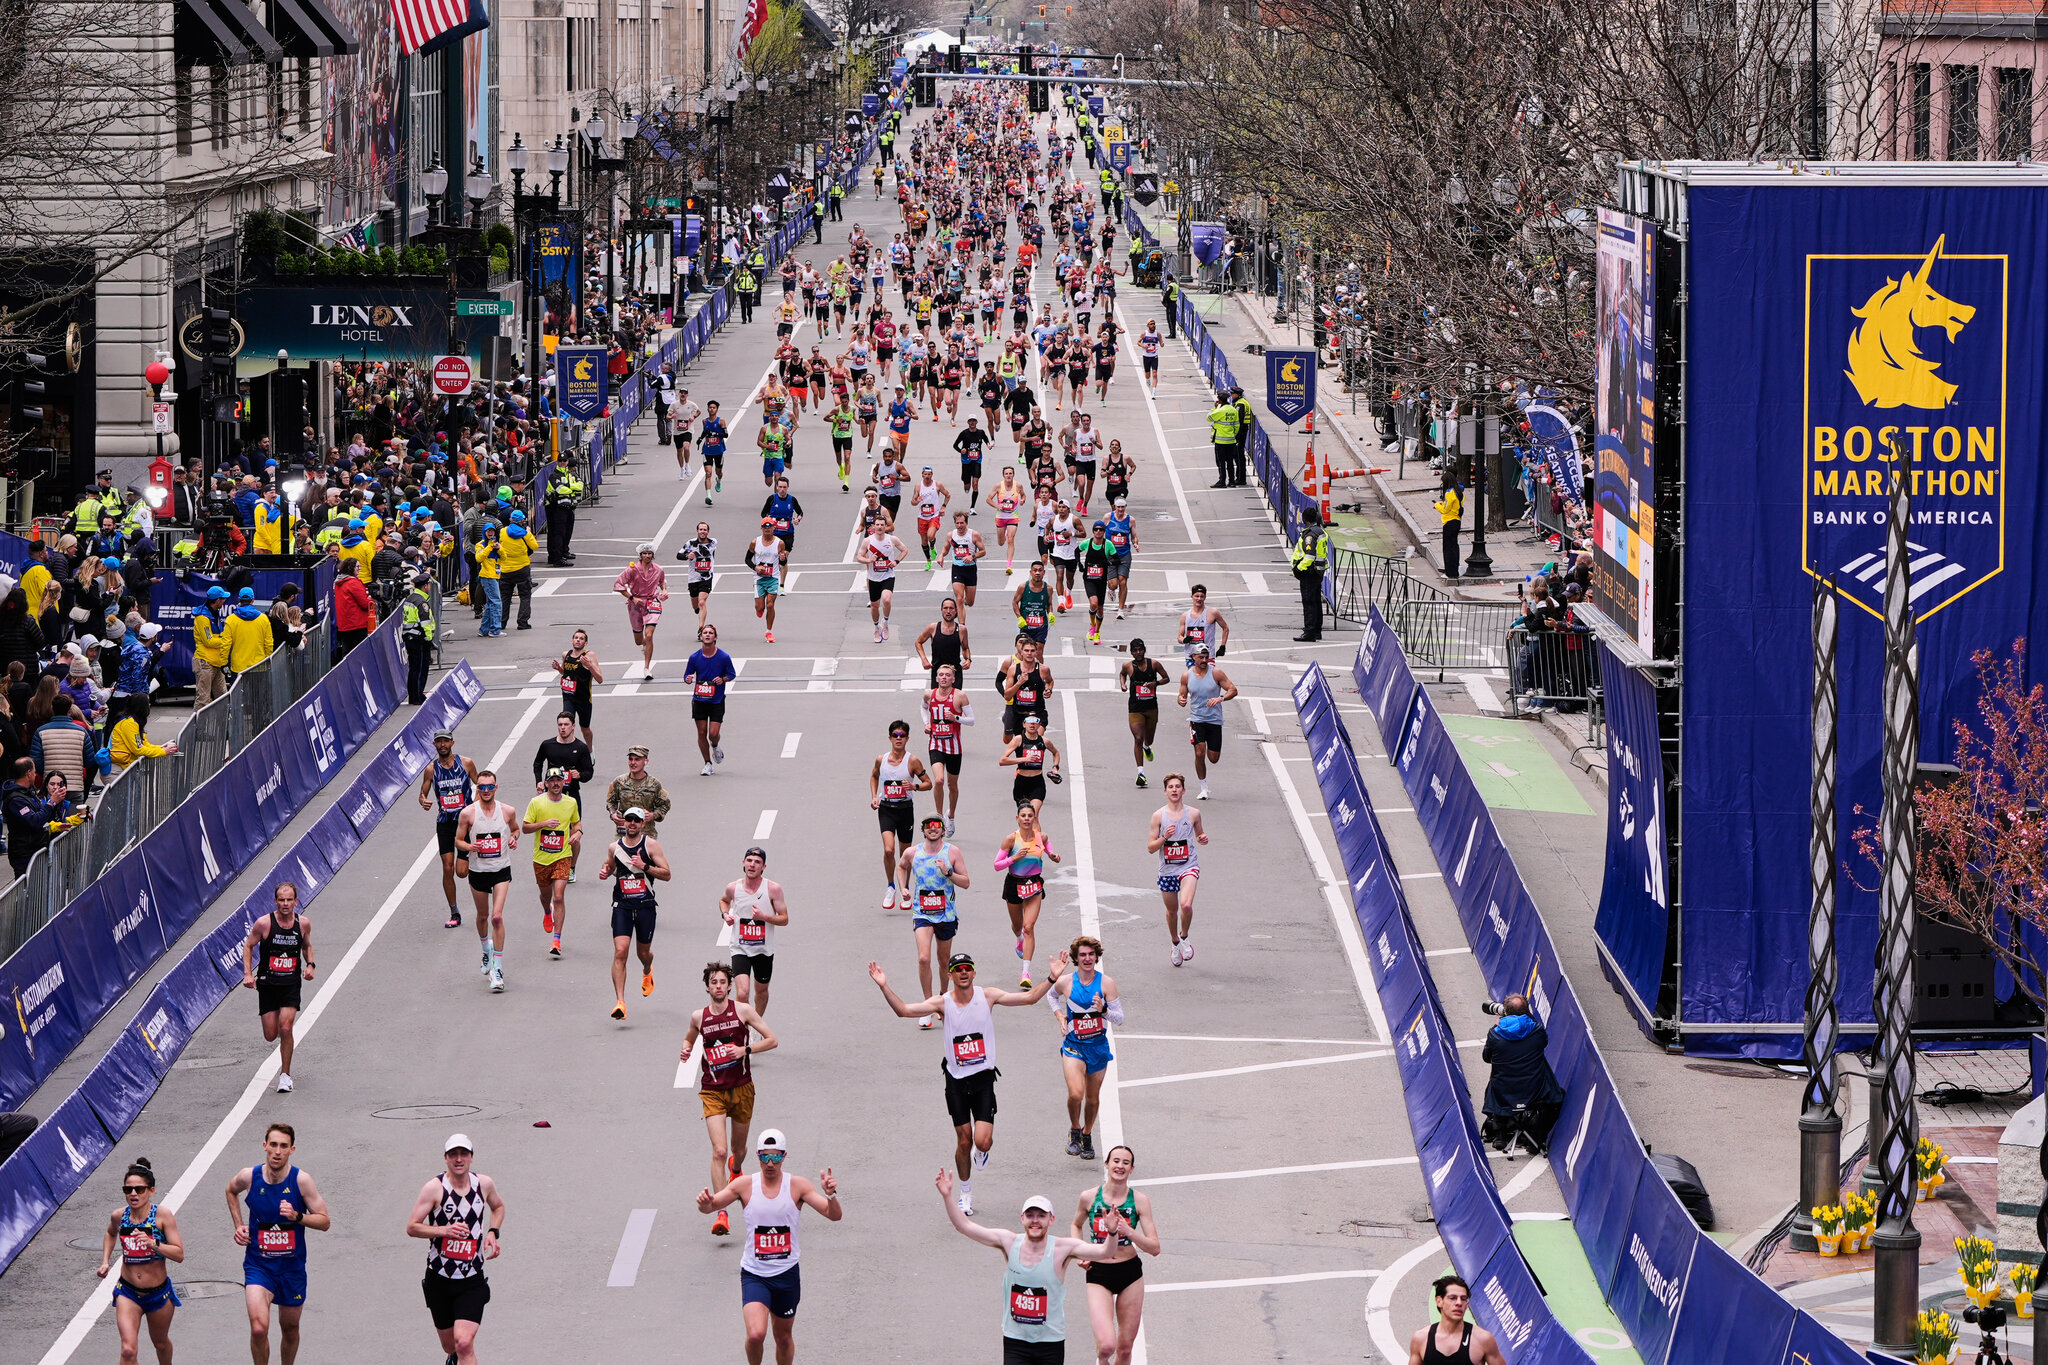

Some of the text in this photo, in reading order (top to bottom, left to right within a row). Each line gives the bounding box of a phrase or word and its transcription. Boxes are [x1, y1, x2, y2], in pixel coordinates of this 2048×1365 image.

[1107, 130, 1119, 138] 26
[468, 304, 499, 315] EXETER
[341, 330, 384, 342] HOTEL
[441, 380, 463, 388] ENTER
[1814, 426, 1995, 462] BOSTON
[1544, 446, 1572, 496] SEATING
[1813, 511, 1867, 525] BANK
[1873, 511, 1887, 525] O
[543, 835, 561, 846] 3422
[273, 957, 293, 968] 4790
[703, 1023, 720, 1034] BOSTON
[1077, 1018, 1098, 1030] 2504
[710, 1047, 727, 1060] 115
[958, 1041, 979, 1055] 5241
[263, 1232, 289, 1245] 5333
[760, 1235, 785, 1247] 6114
[447, 1240, 472, 1254] 2074
[1015, 1294, 1040, 1311] 4351
